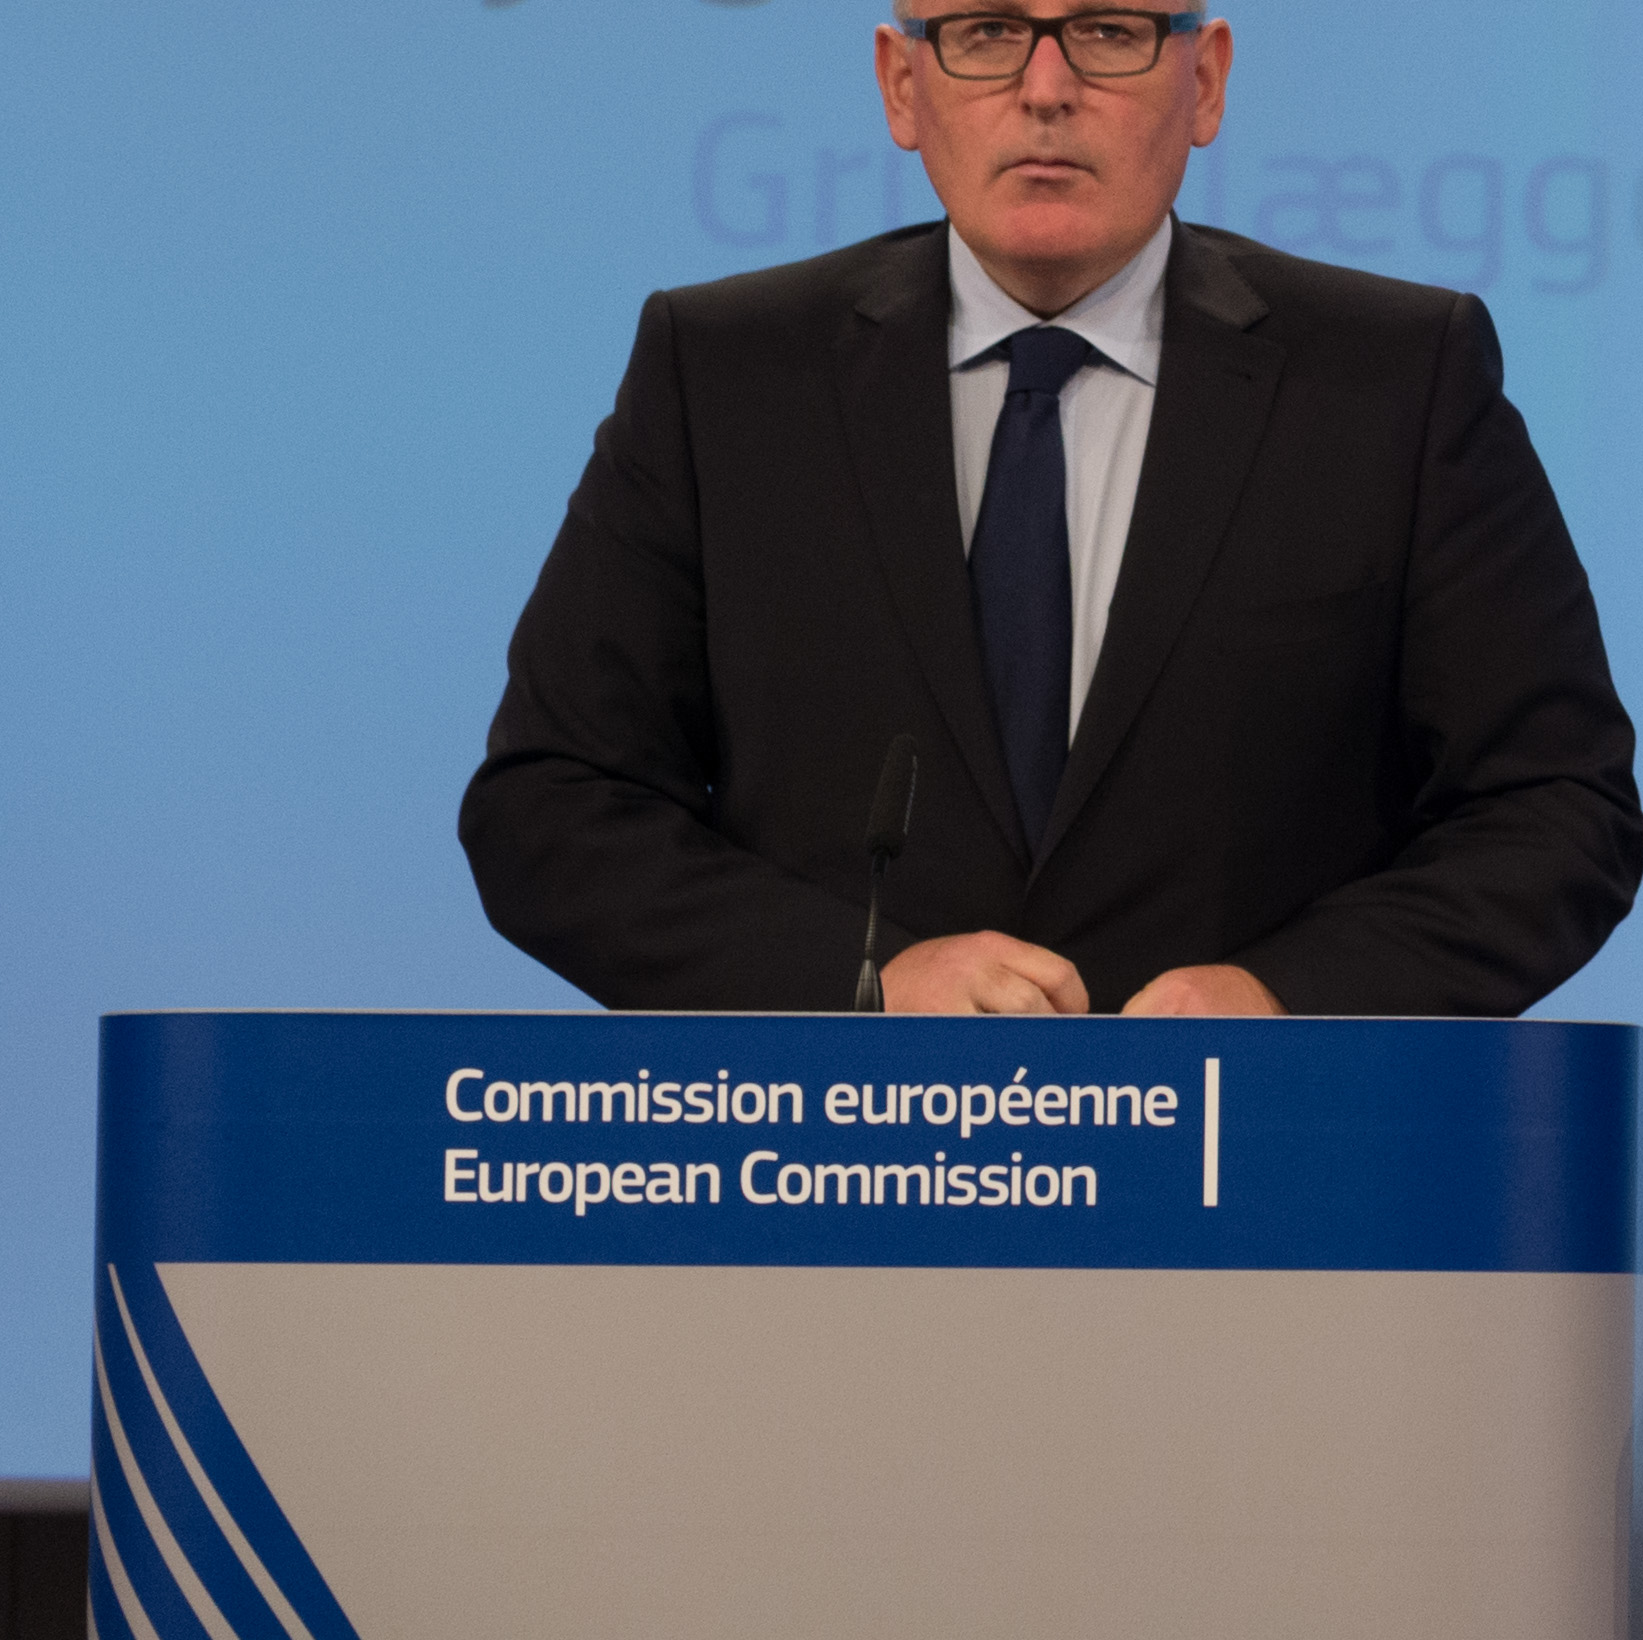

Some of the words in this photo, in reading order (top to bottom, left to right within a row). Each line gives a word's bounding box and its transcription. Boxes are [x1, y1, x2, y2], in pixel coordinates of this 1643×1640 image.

[444, 1067, 804, 1124] Commission
[823, 1066, 1179, 1139] européenne
[443, 1148, 721, 1217] European
[739, 1149, 1098, 1207] Commission
